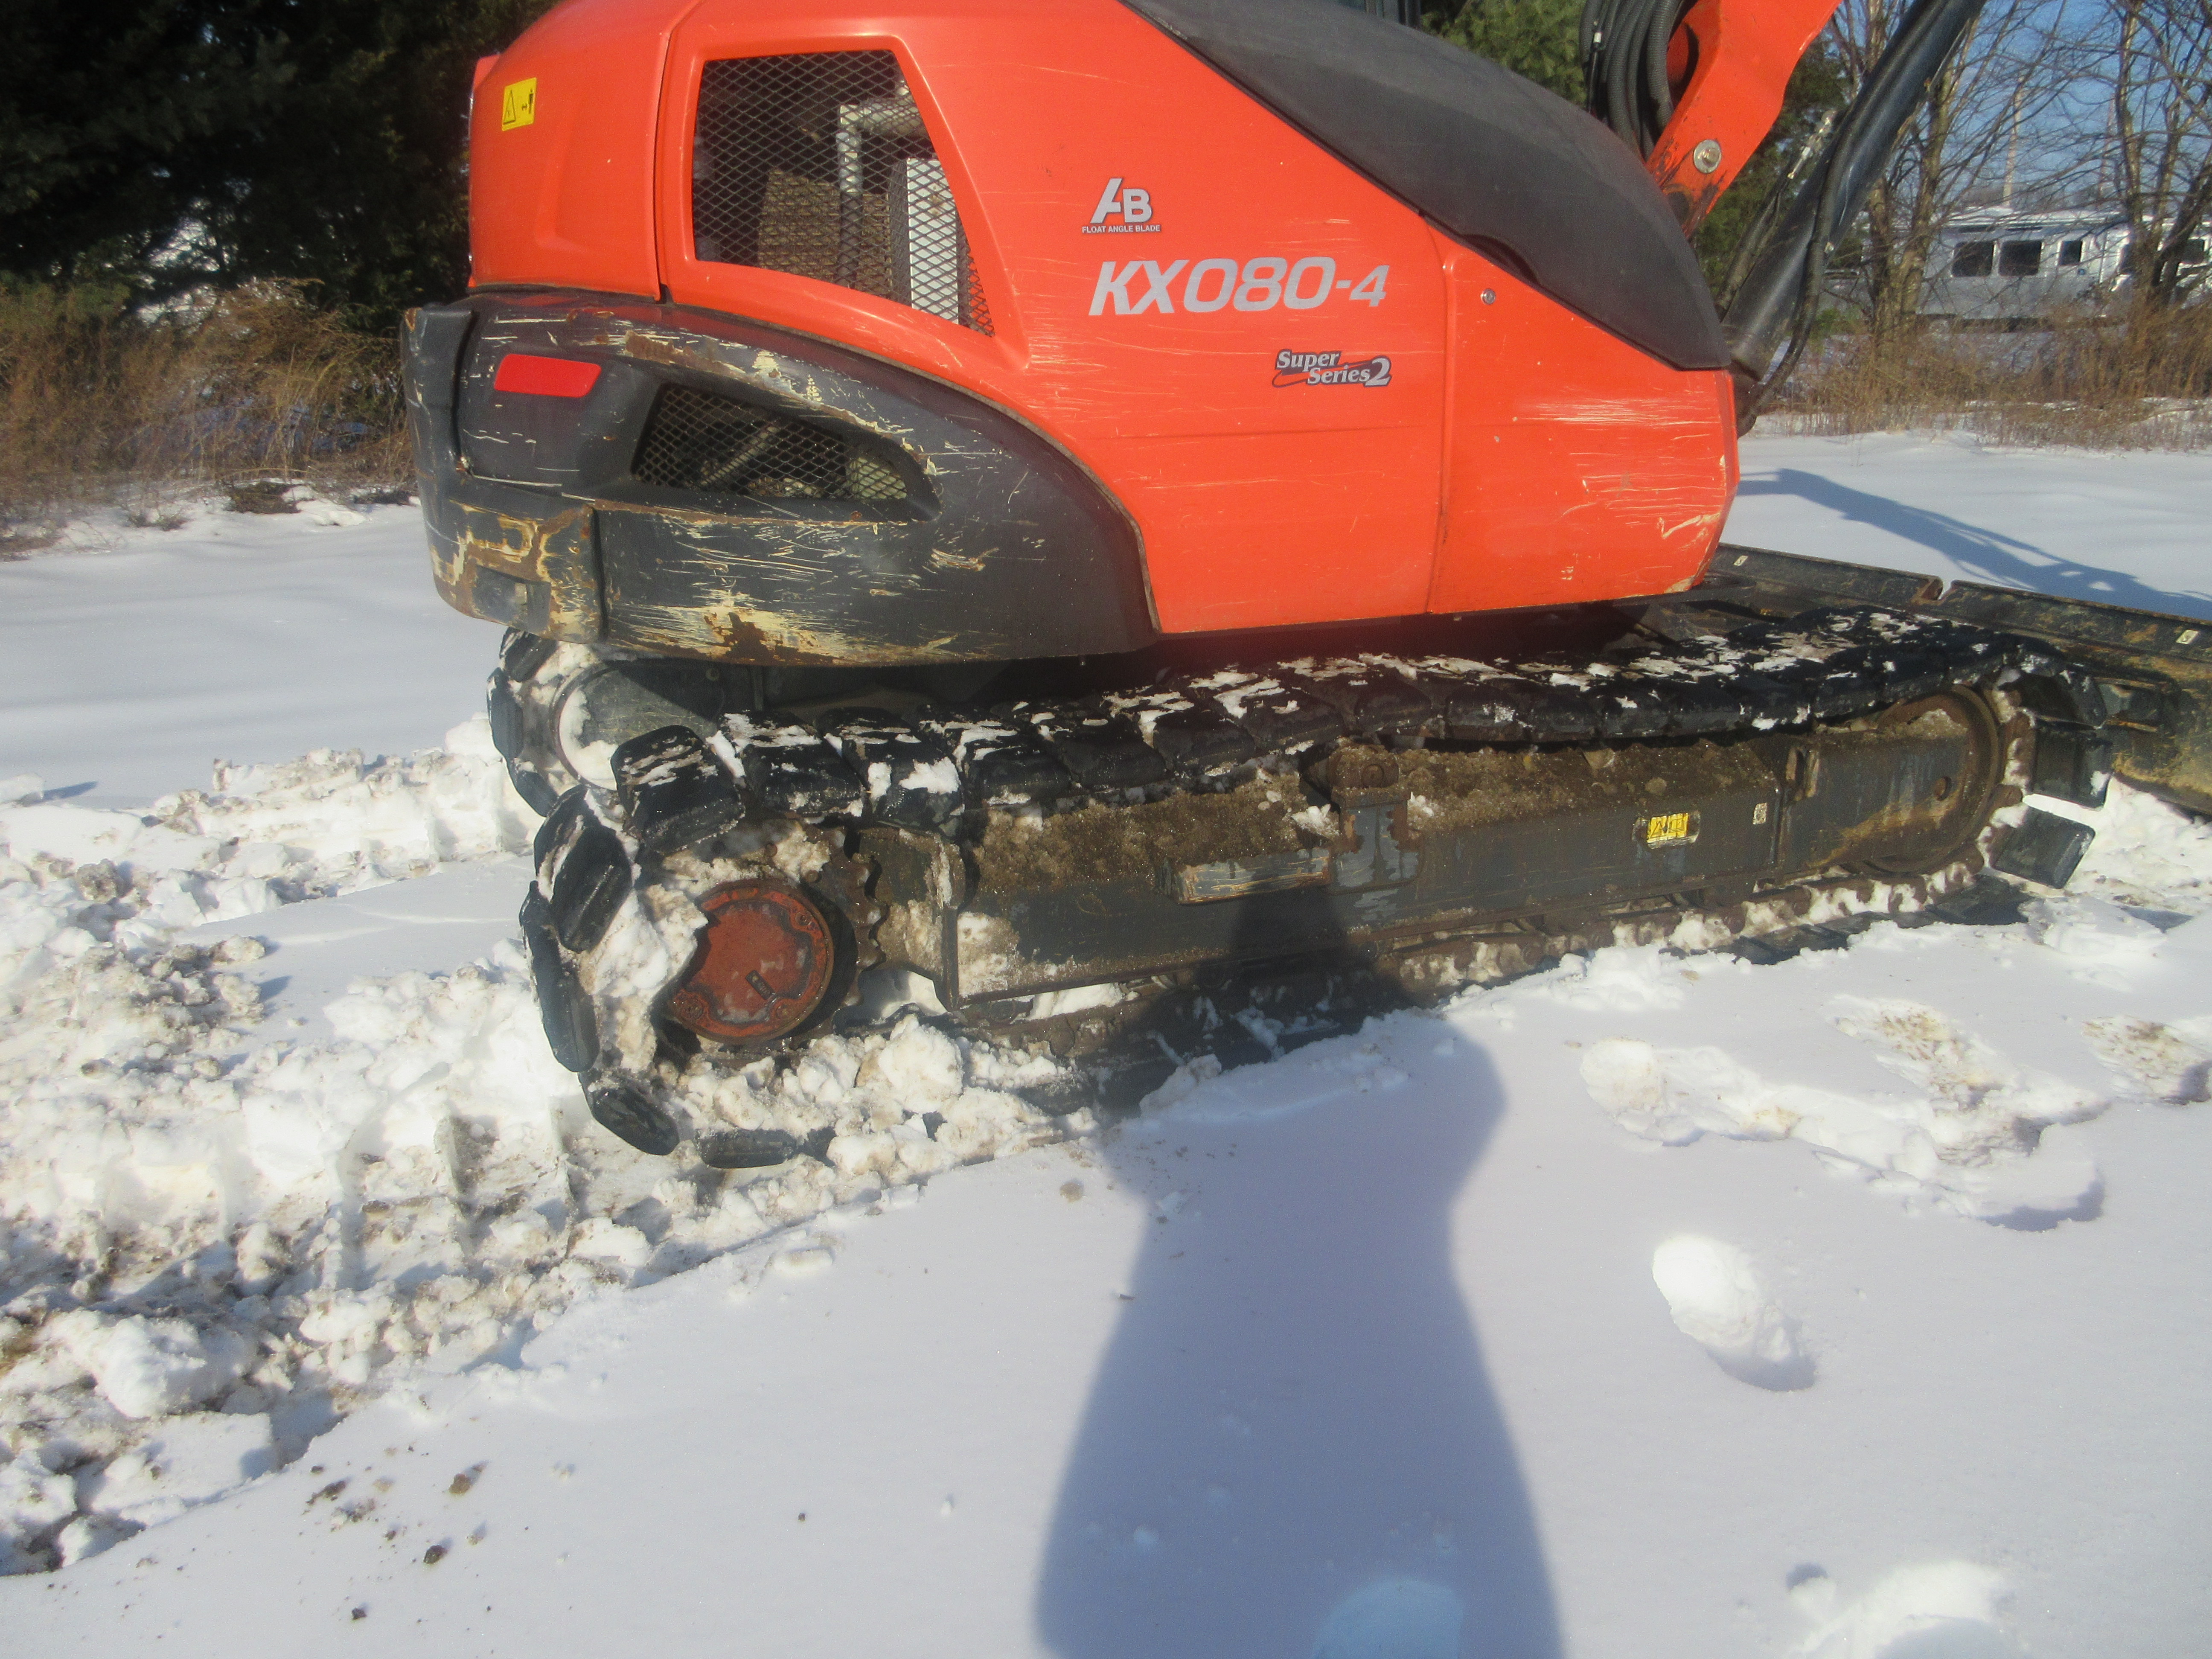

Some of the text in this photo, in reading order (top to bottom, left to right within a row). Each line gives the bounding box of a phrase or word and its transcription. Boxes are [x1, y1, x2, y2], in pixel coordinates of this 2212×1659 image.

[1090, 178, 1153, 224] AB
[1088, 256, 1390, 316] KX080-4
[1277, 351, 1340, 372] Super
